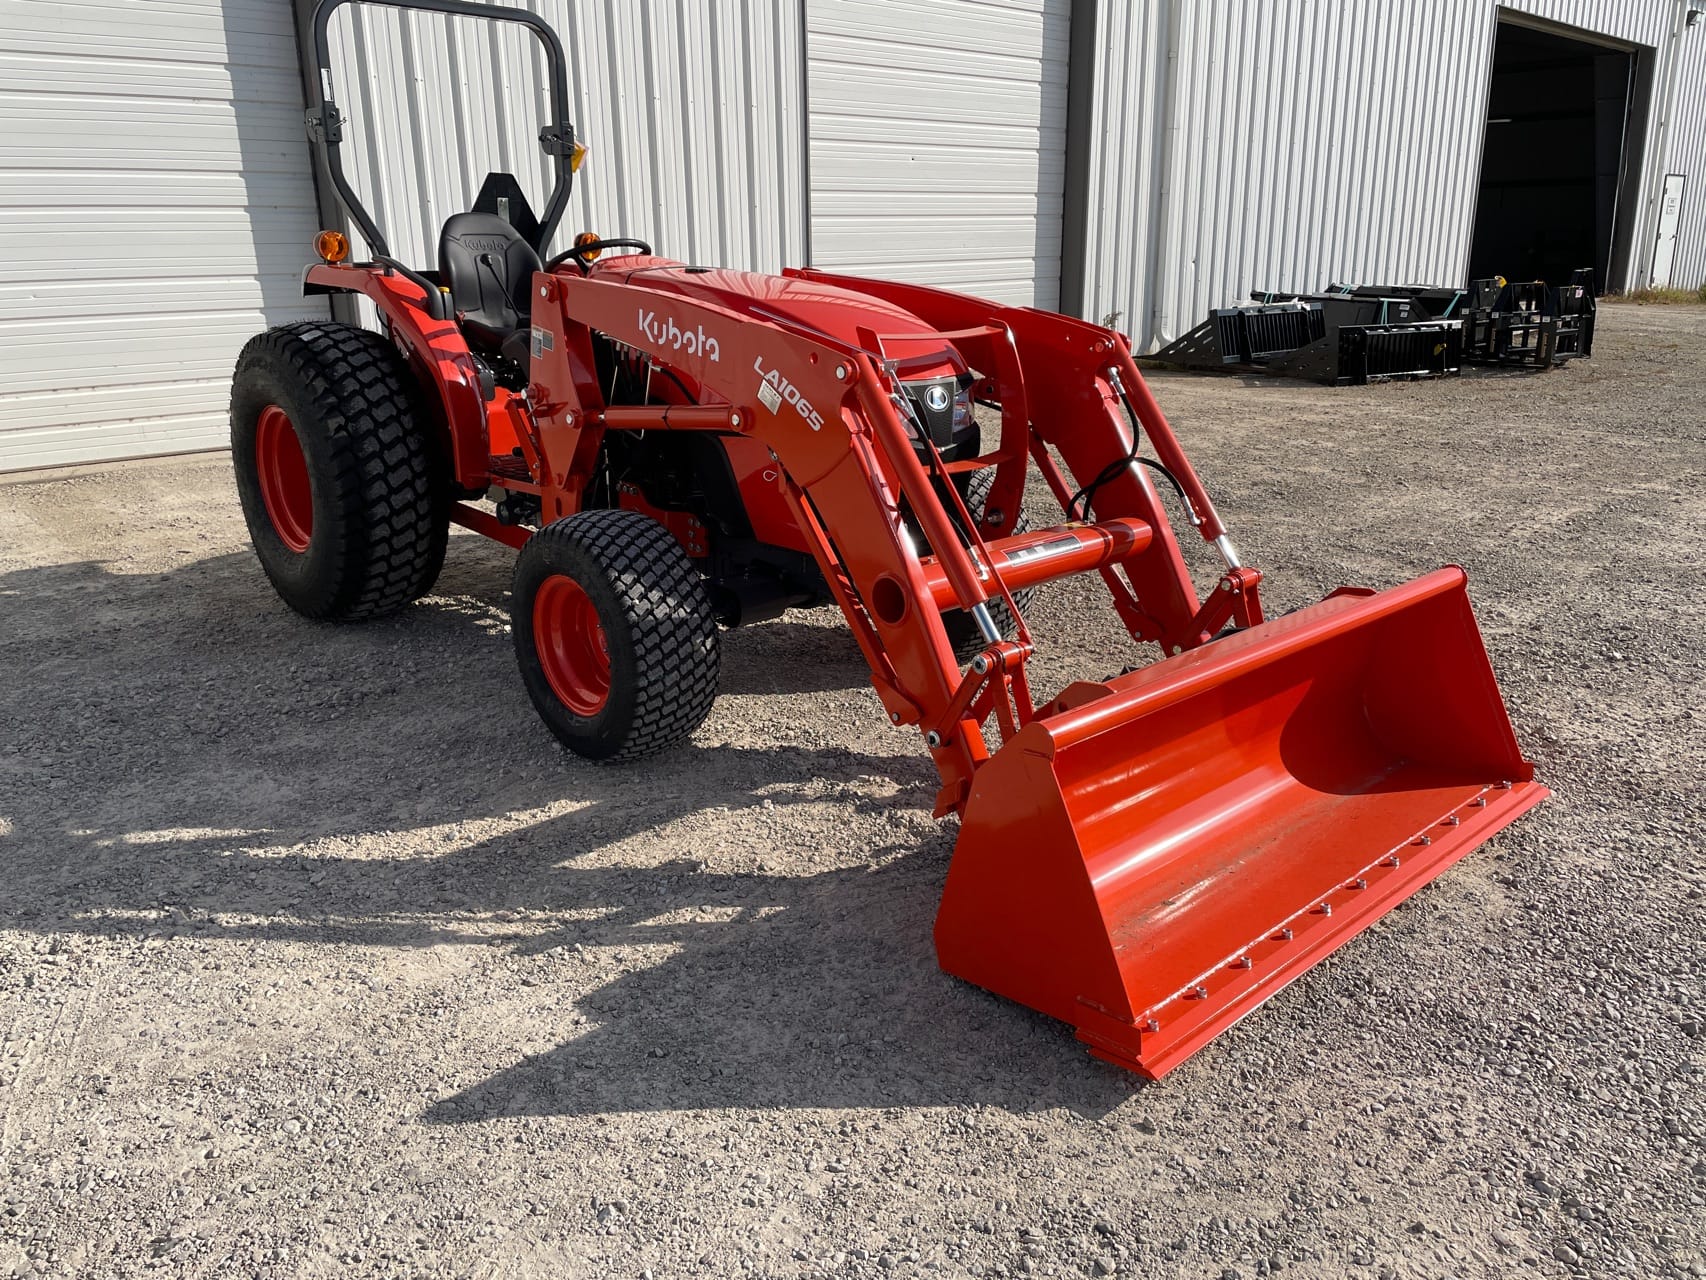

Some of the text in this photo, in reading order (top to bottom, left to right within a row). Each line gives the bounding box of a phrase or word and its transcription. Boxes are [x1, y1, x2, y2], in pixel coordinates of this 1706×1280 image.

[464, 239, 506, 251] Kubota
[638, 308, 720, 362] Kubota
[753, 355, 825, 432] LA1065
